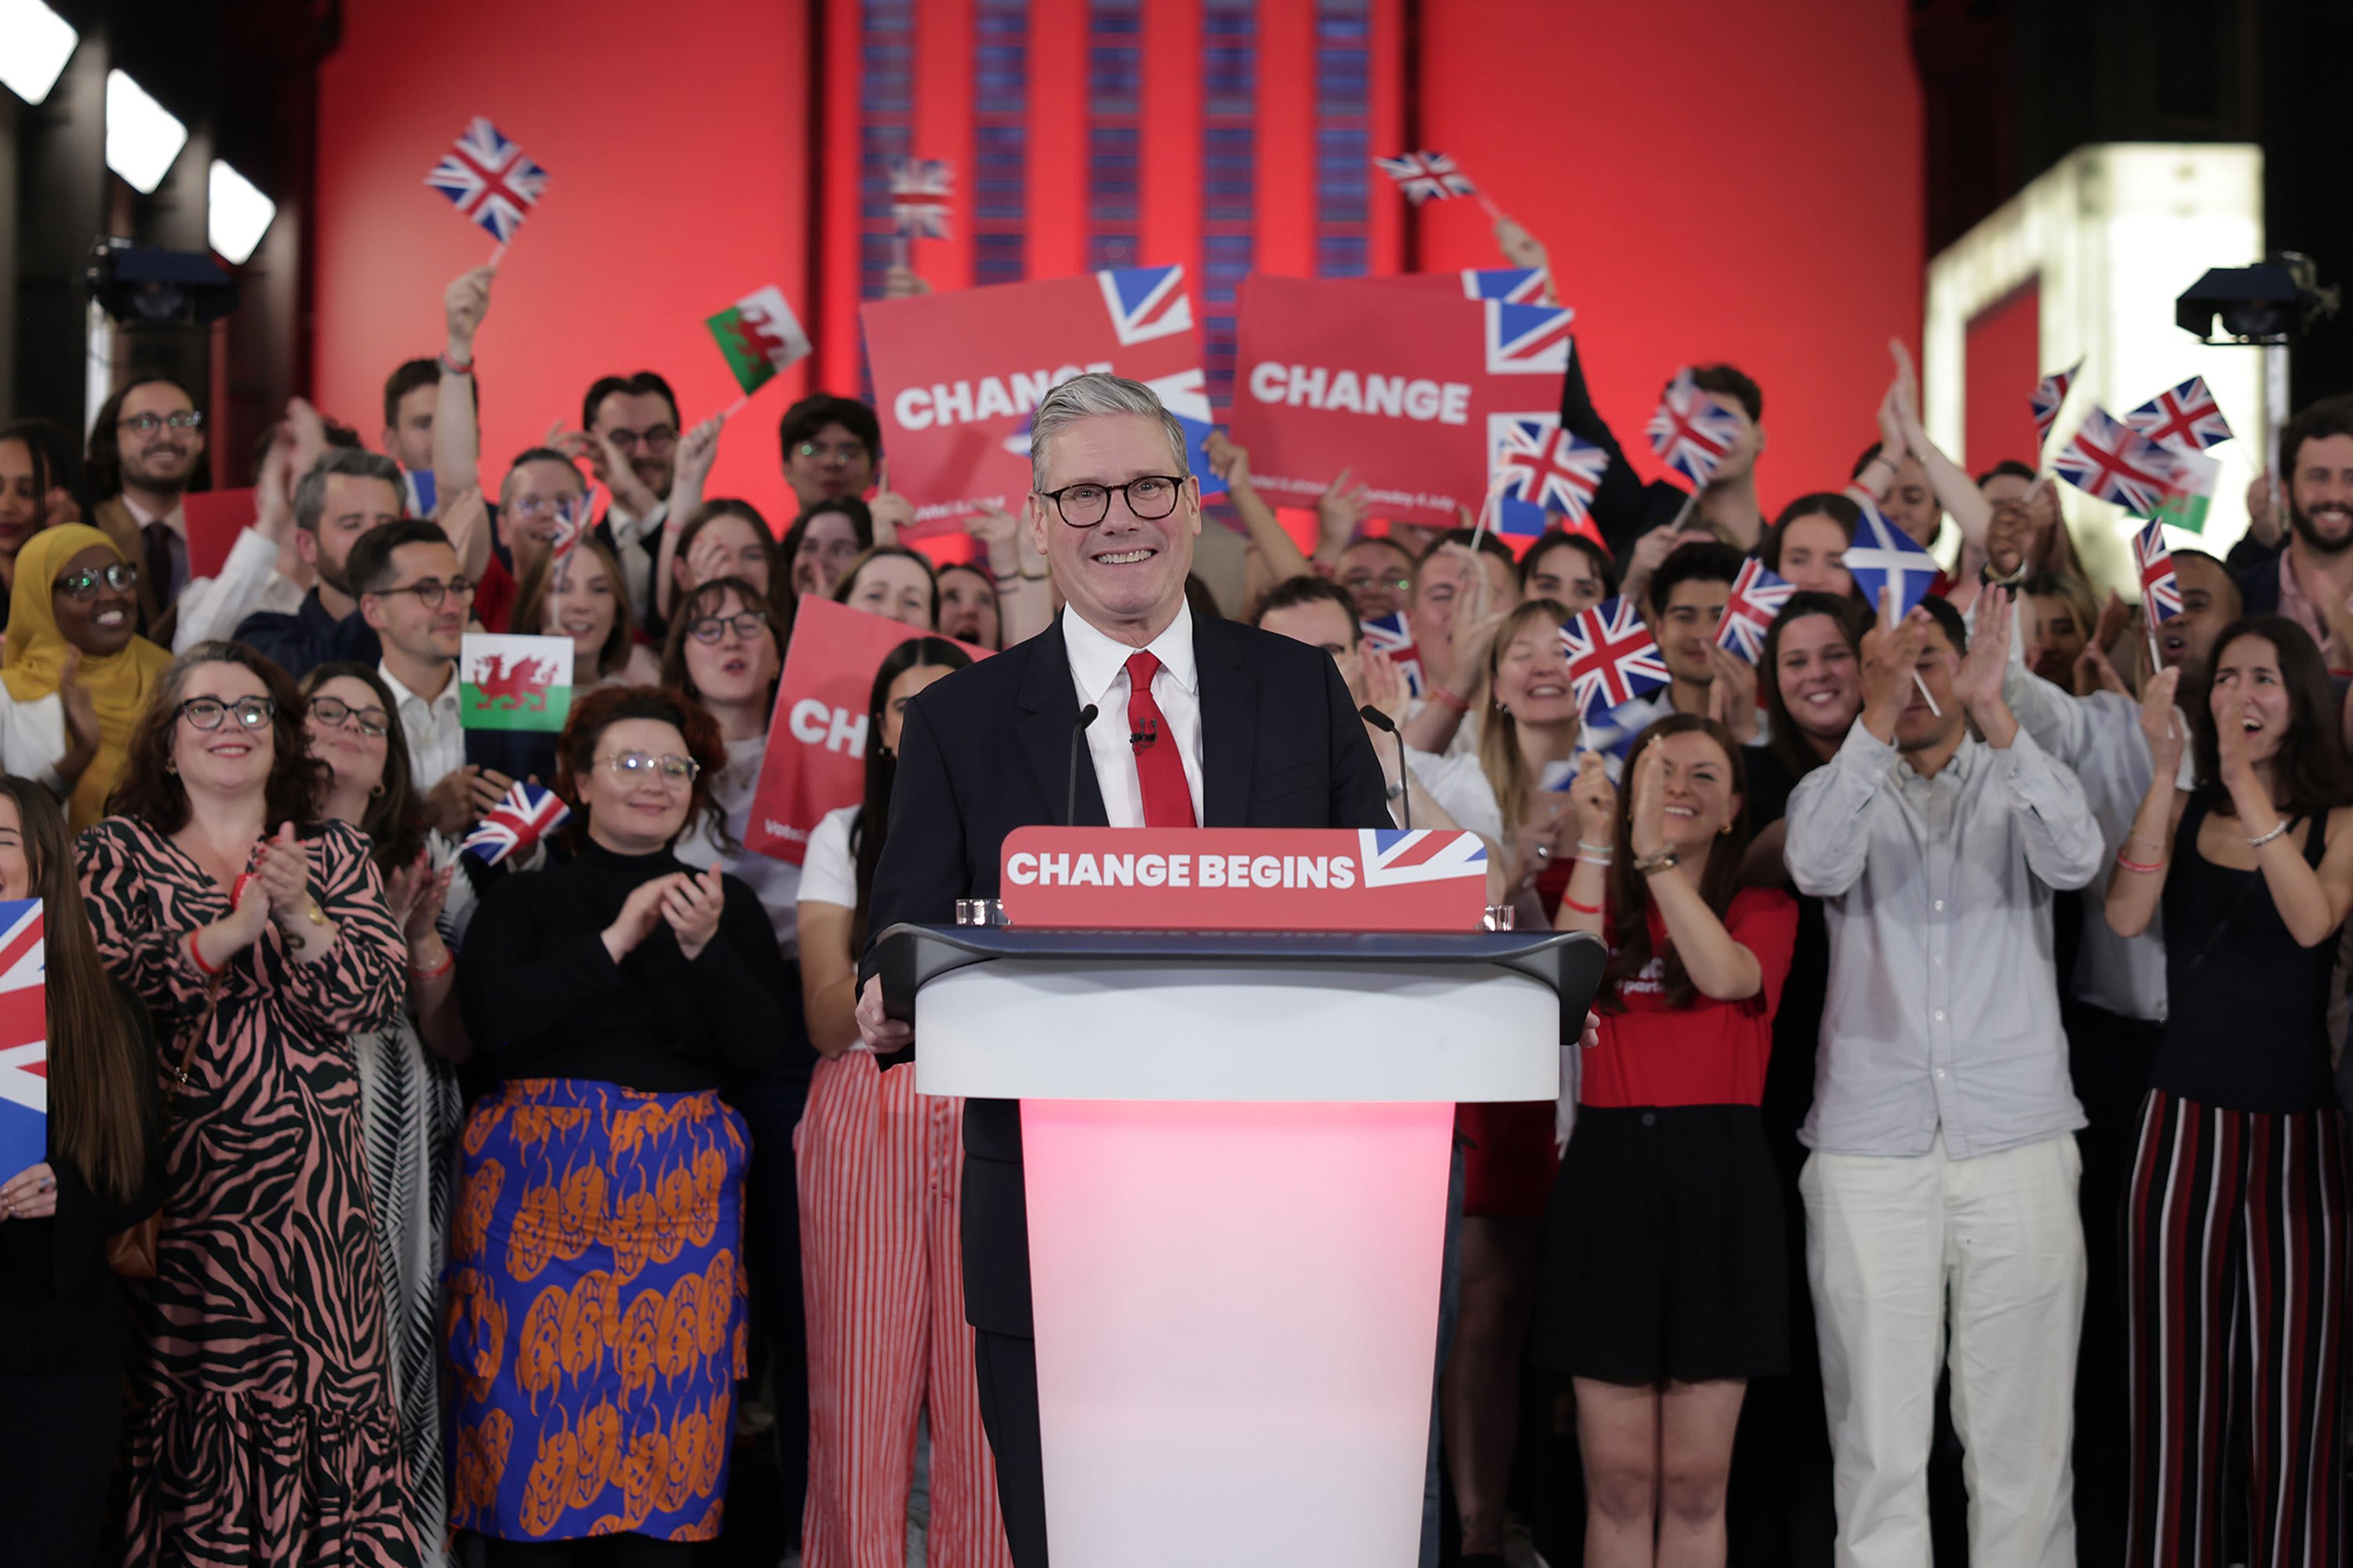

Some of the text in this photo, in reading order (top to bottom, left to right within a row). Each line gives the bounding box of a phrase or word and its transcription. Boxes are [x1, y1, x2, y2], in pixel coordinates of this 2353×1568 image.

[895, 362, 1112, 430] CHAN
[1250, 362, 1471, 424] CHANGE
[1007, 852, 1355, 889] CHANGE BEGINS
